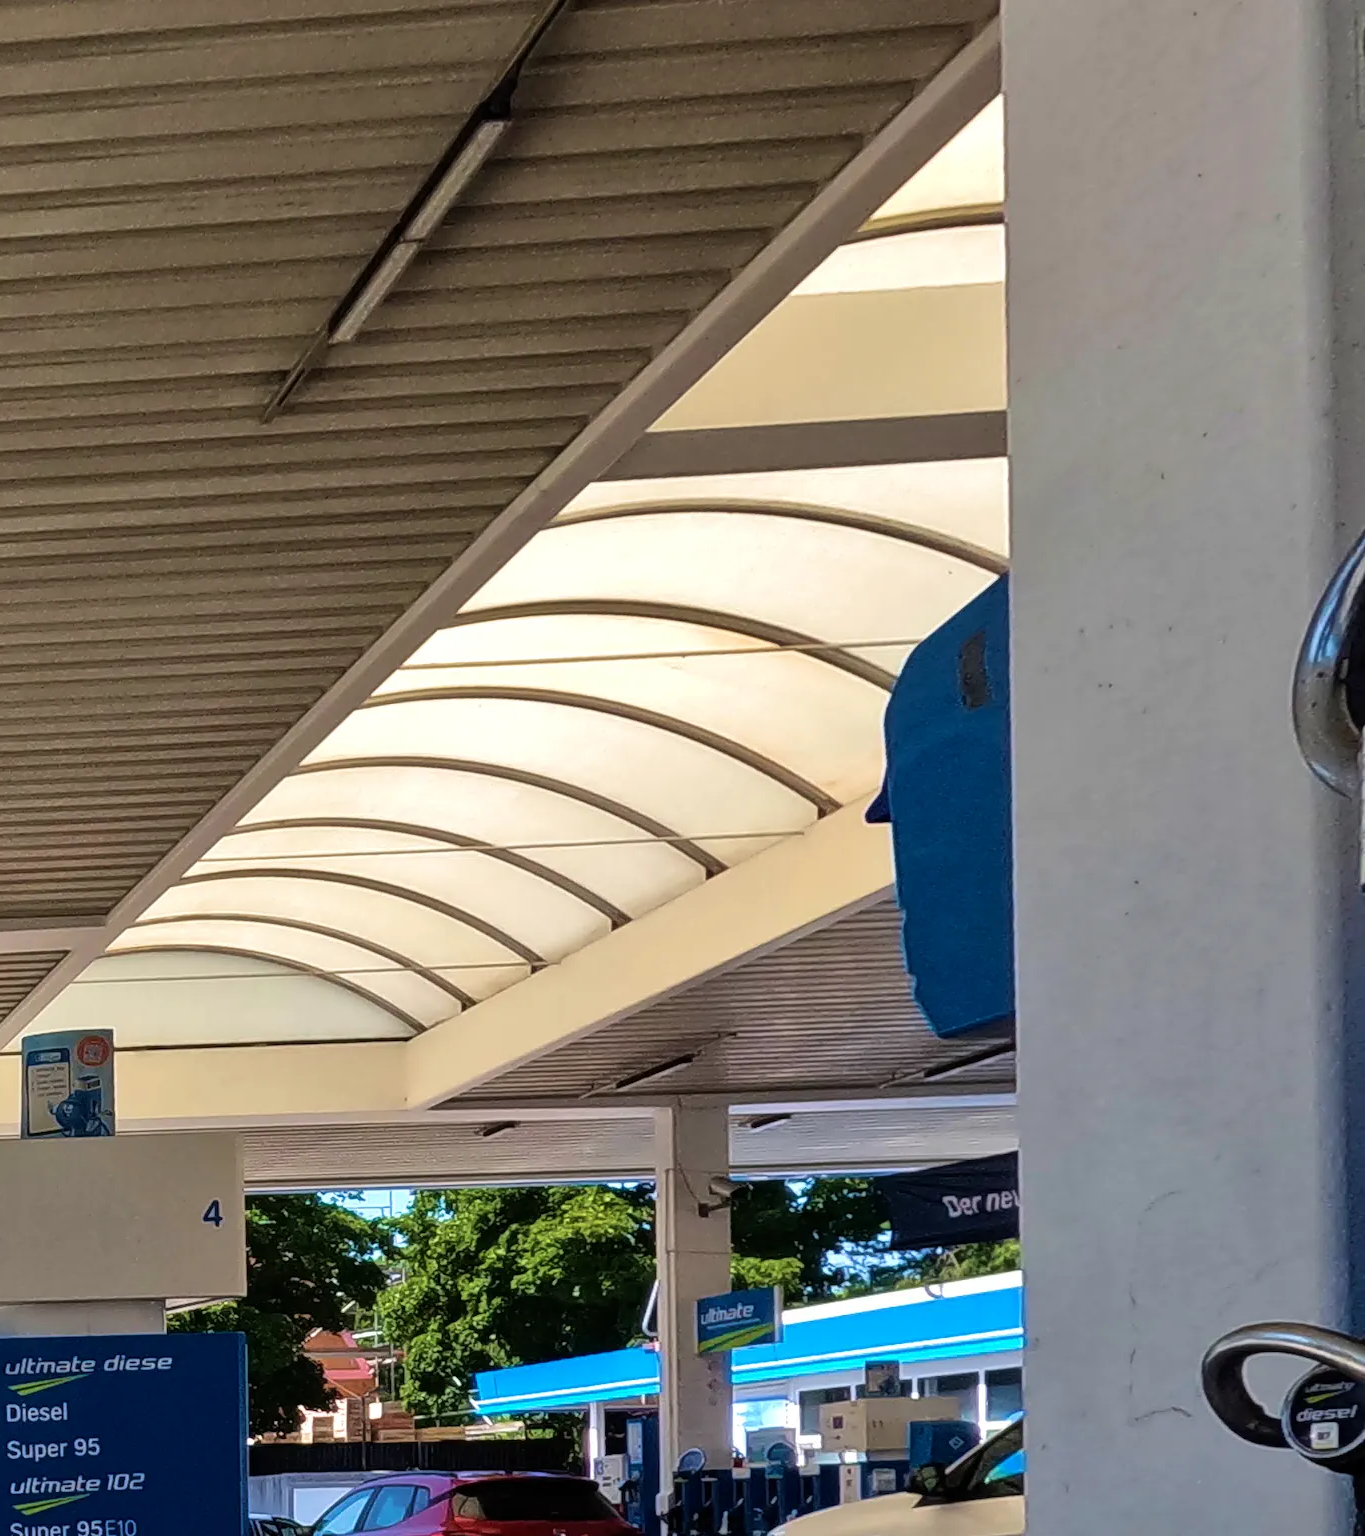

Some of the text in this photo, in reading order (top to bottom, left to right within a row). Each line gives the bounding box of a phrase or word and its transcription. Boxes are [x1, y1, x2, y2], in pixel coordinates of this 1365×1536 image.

[202, 1200, 224, 1228] 4
[941, 1195, 982, 1218] Der
[700, 1302, 755, 1325] ultimate
[5, 1354, 173, 1375] ultimate diese
[6, 1402, 68, 1422] Diesel
[1295, 1404, 1358, 1422] diesel
[7, 1437, 101, 1462] Super 95
[9, 1472, 146, 1494] ultimate 102
